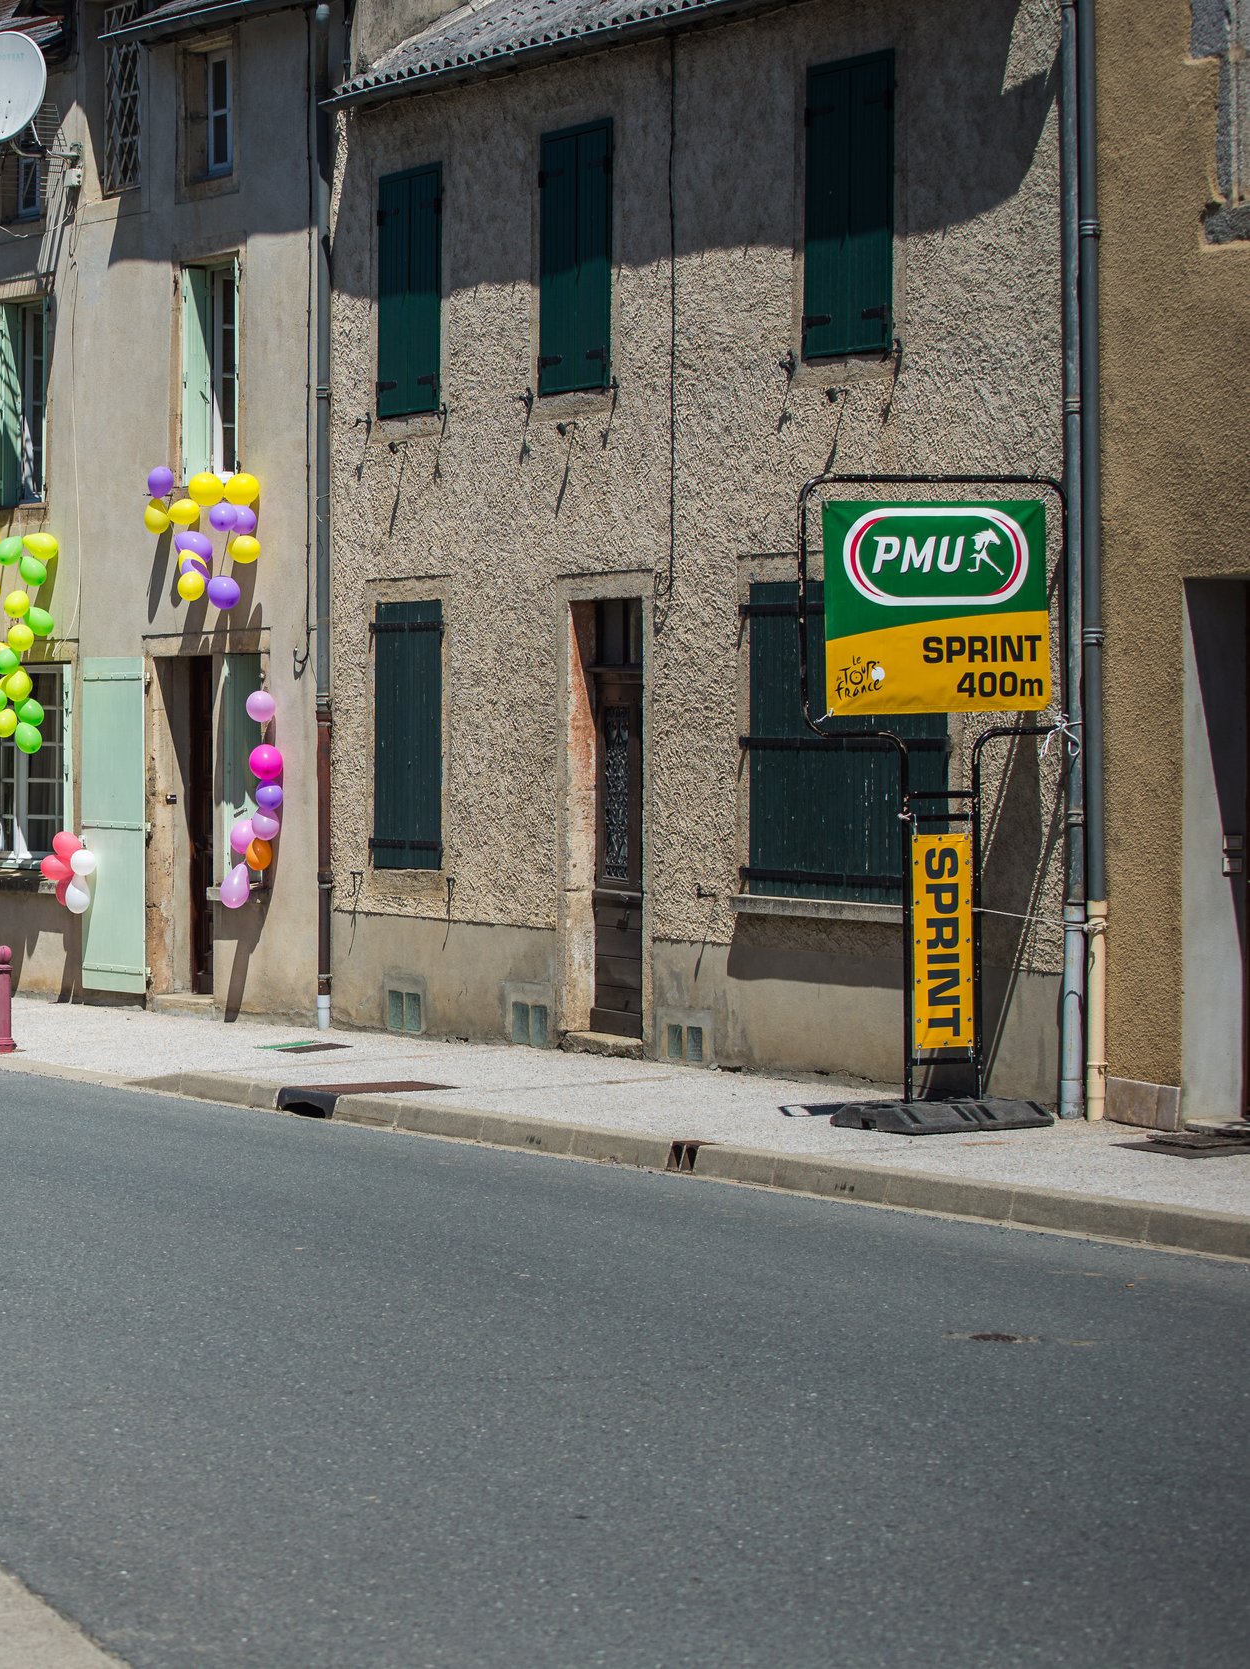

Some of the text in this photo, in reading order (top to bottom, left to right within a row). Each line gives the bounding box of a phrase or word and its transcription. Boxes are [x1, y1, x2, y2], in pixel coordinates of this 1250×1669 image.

[872, 535, 966, 574] PMU
[922, 634, 1042, 664] SPRINT
[956, 671, 1044, 698] 400m
[924, 847, 961, 1037] SPRINT
